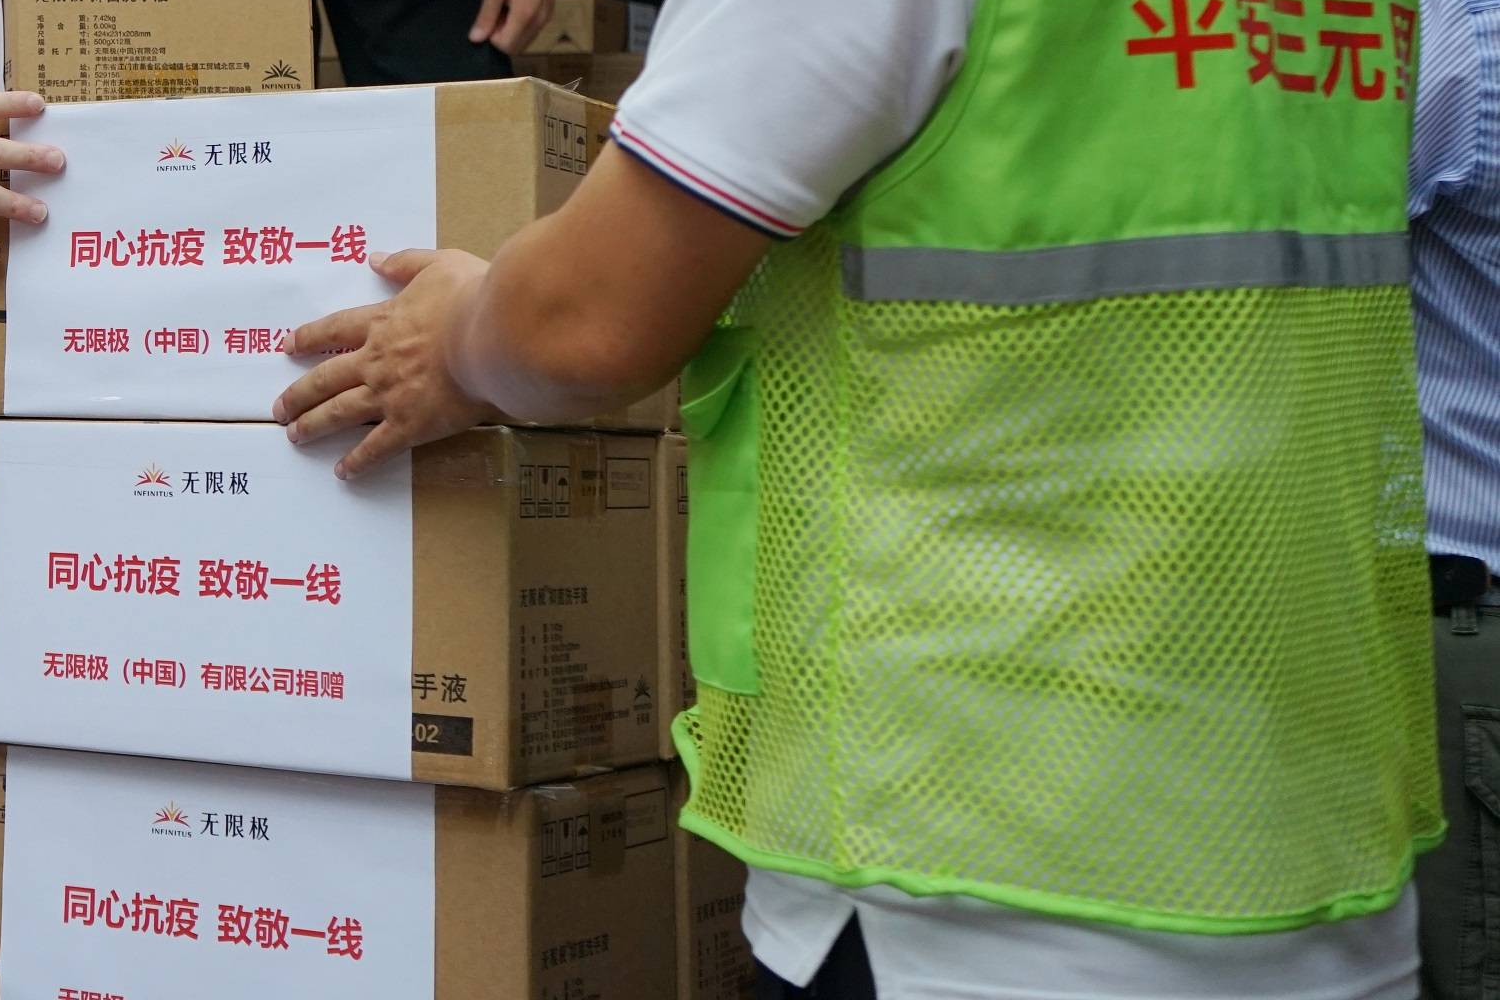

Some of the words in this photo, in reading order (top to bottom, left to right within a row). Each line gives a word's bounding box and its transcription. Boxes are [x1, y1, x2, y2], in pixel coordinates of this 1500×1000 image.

[203, 140, 273, 166] 无限极
[156, 163, 197, 172] INFINITUS
[69, 228, 206, 268] 同心抗疫
[223, 224, 369, 266] 致敬一线
[133, 489, 174, 498] INFINITUS
[181, 469, 251, 496] 无限极
[47, 551, 181, 597] 同心抗疫
[198, 558, 342, 606] 致敬一线
[42, 651, 345, 701] 无限极（中国）有限公司捐赠
[151, 827, 192, 839] INFINITUS
[200, 811, 271, 841] 无限极
[63, 884, 199, 941] 同心抗疫
[217, 903, 364, 961] 致敬一线
